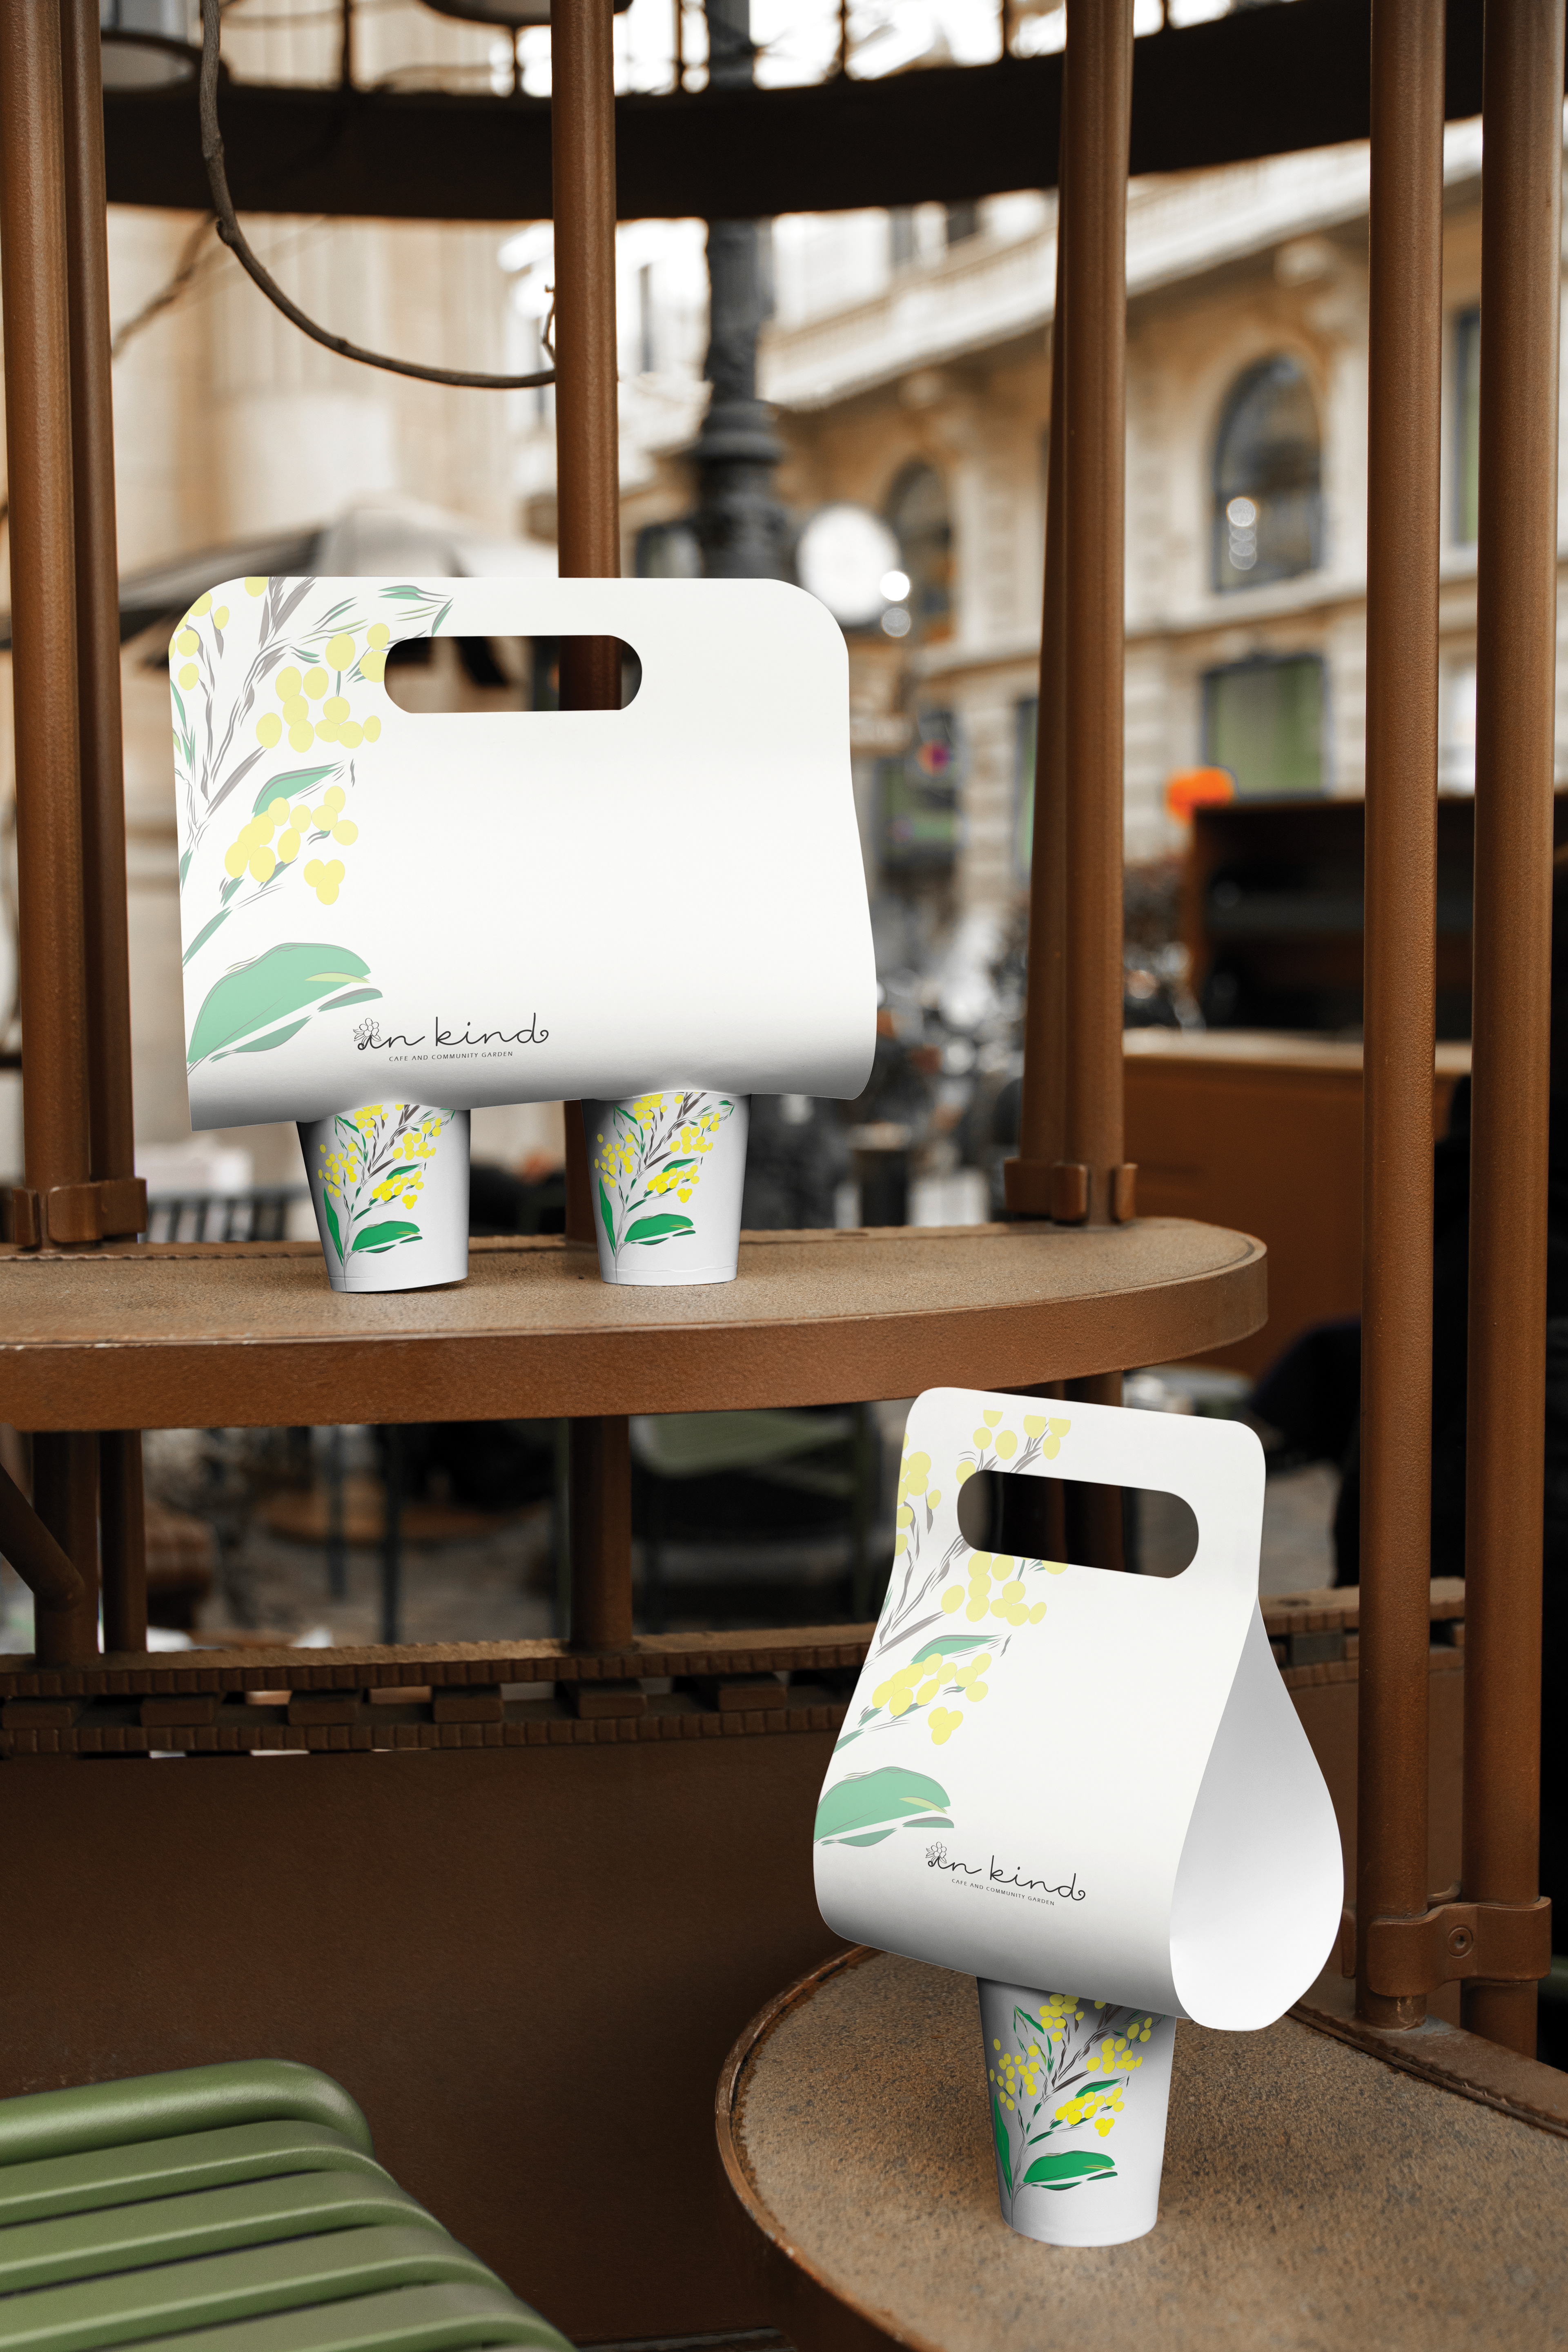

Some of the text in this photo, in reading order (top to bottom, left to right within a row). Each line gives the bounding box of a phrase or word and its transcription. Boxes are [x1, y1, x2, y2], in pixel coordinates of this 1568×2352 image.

[436, 1013, 549, 1046] kind
[990, 1855, 1085, 1900] kind
[986, 1886, 1025, 1899] COMMUNITY
[1028, 1896, 1055, 1906] GARDEN
